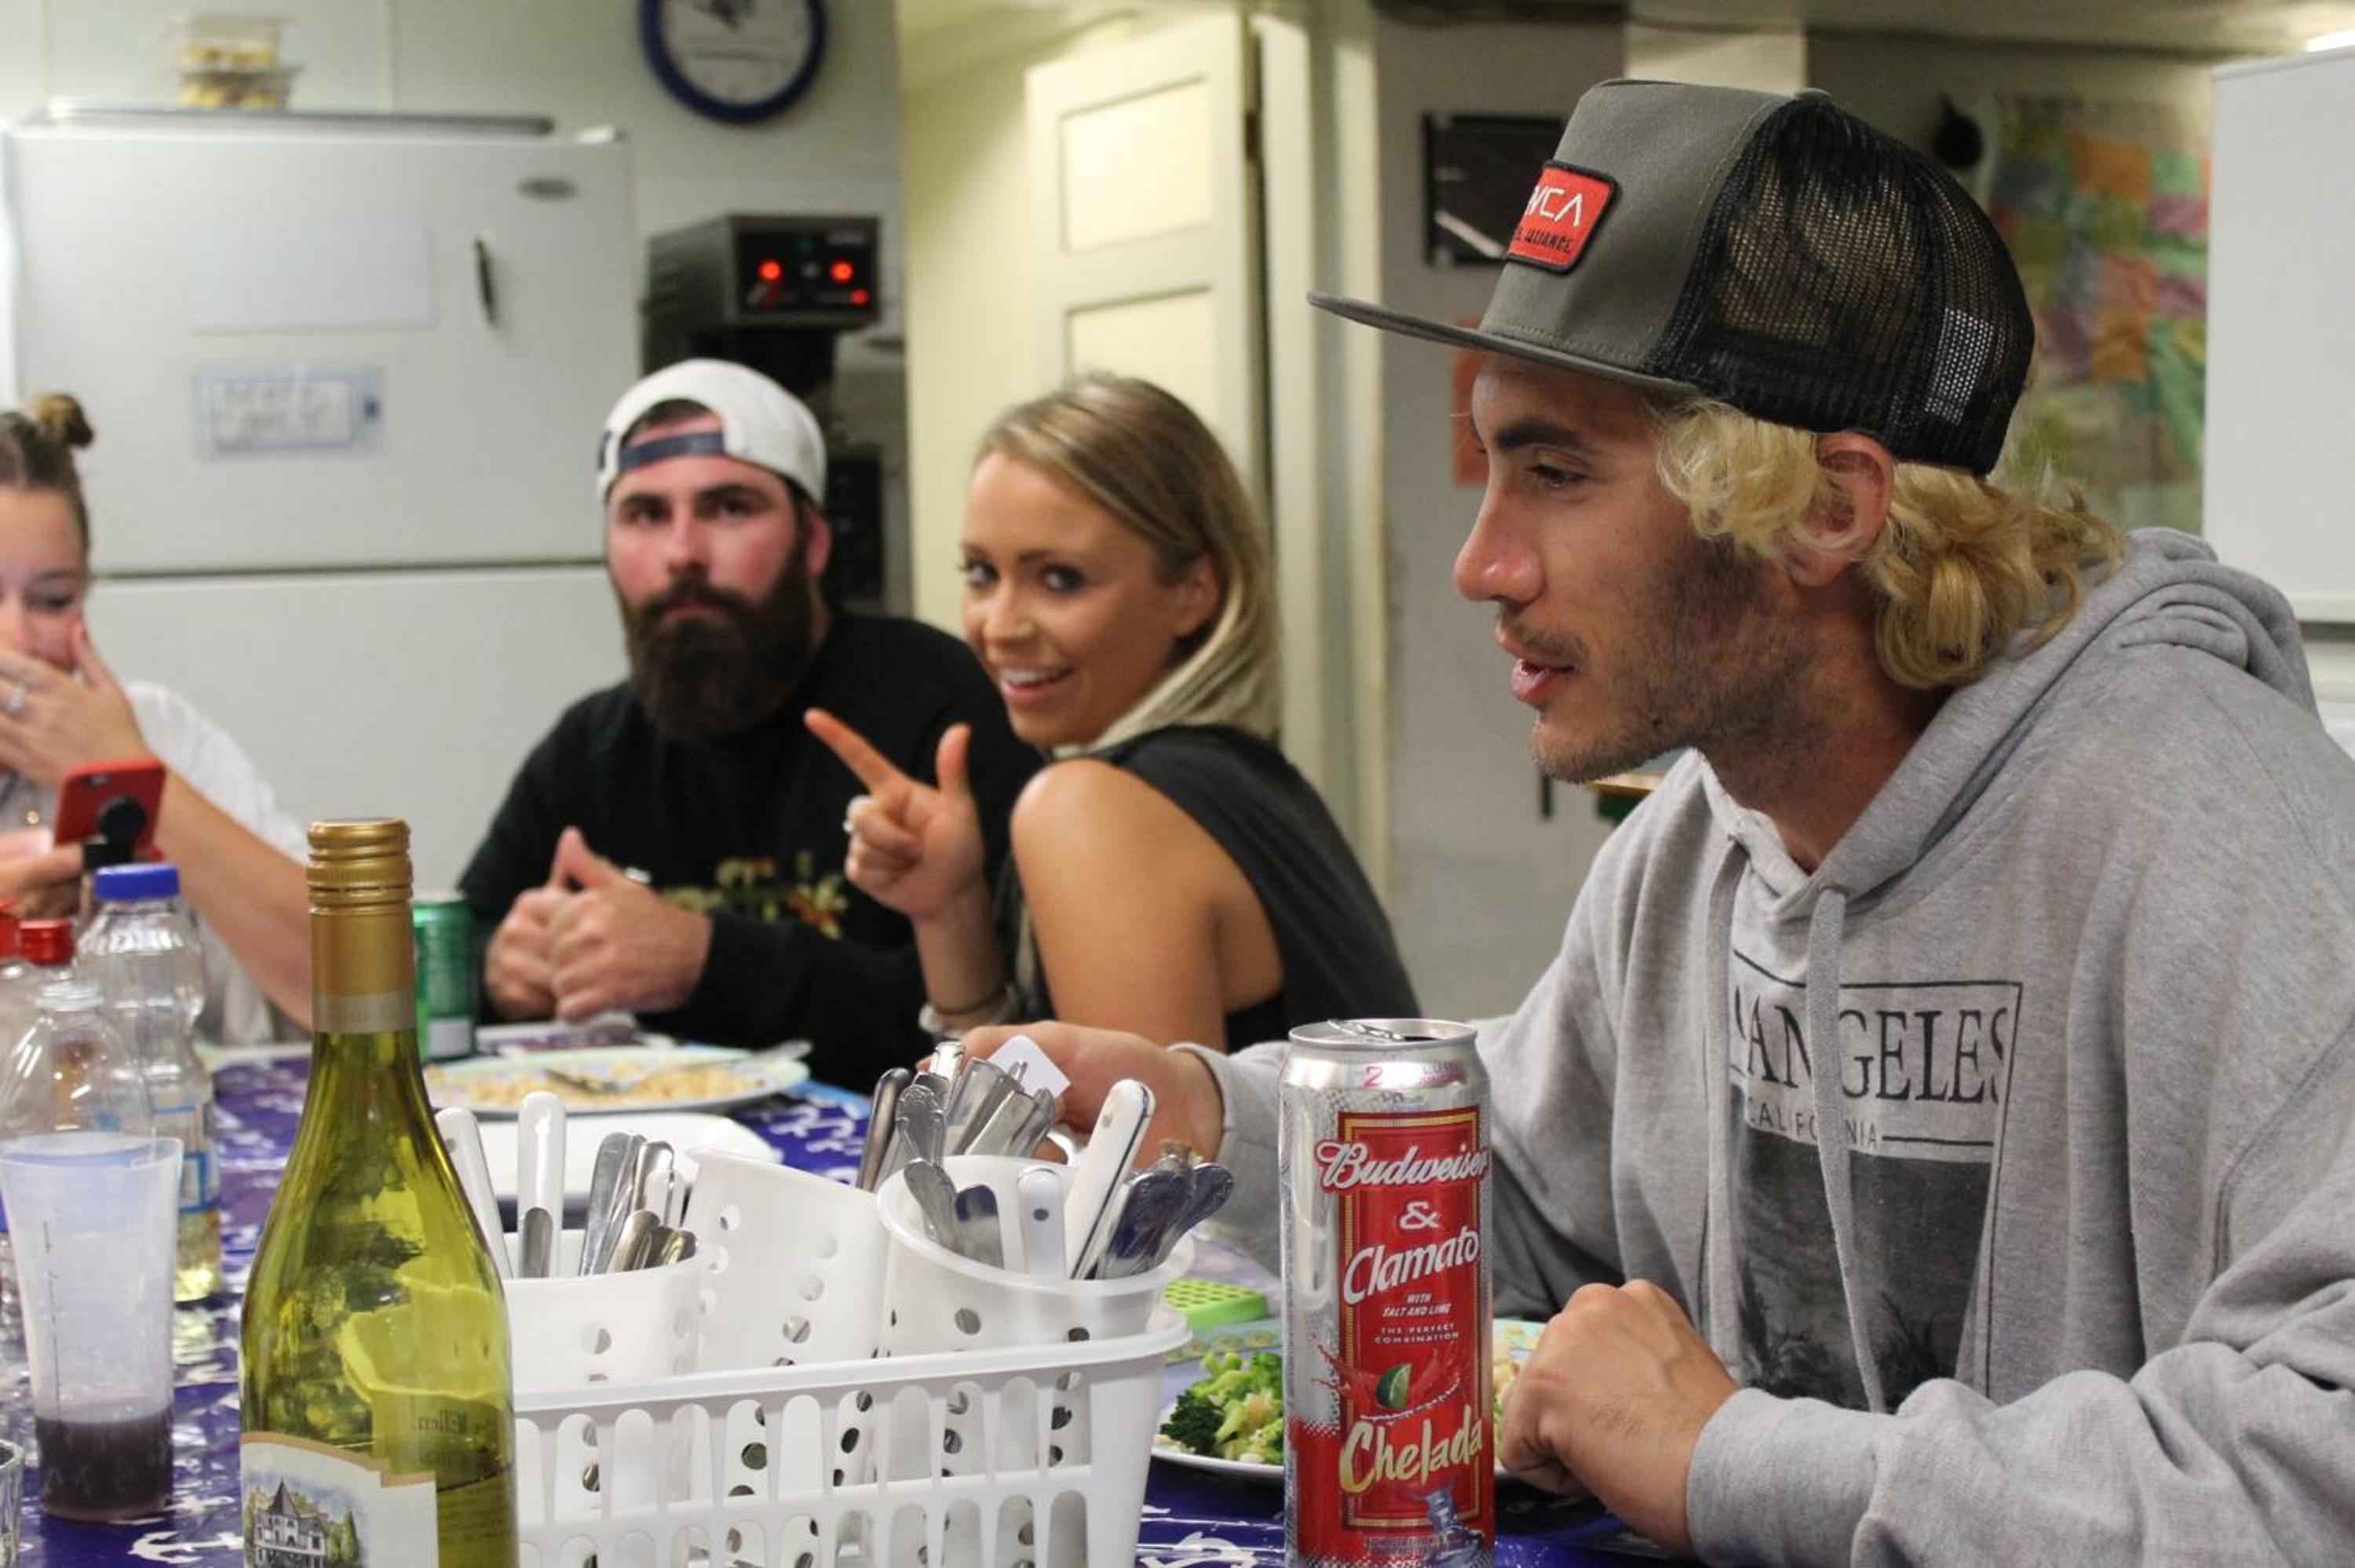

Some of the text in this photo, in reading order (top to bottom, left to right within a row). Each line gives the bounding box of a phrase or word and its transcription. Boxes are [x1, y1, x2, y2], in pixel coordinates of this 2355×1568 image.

[1316, 1140, 1488, 1189] Budweiser
[1400, 1202, 1440, 1230] &
[1344, 1226, 1479, 1304] Clamato
[1407, 1293, 1432, 1303] WITH
[1382, 1304, 1451, 1317] SALT AND LIME
[1375, 1333, 1459, 1344] COMBINATION
[1382, 1323, 1455, 1335] THE PERFECT
[1339, 1405, 1482, 1493] Chelada
